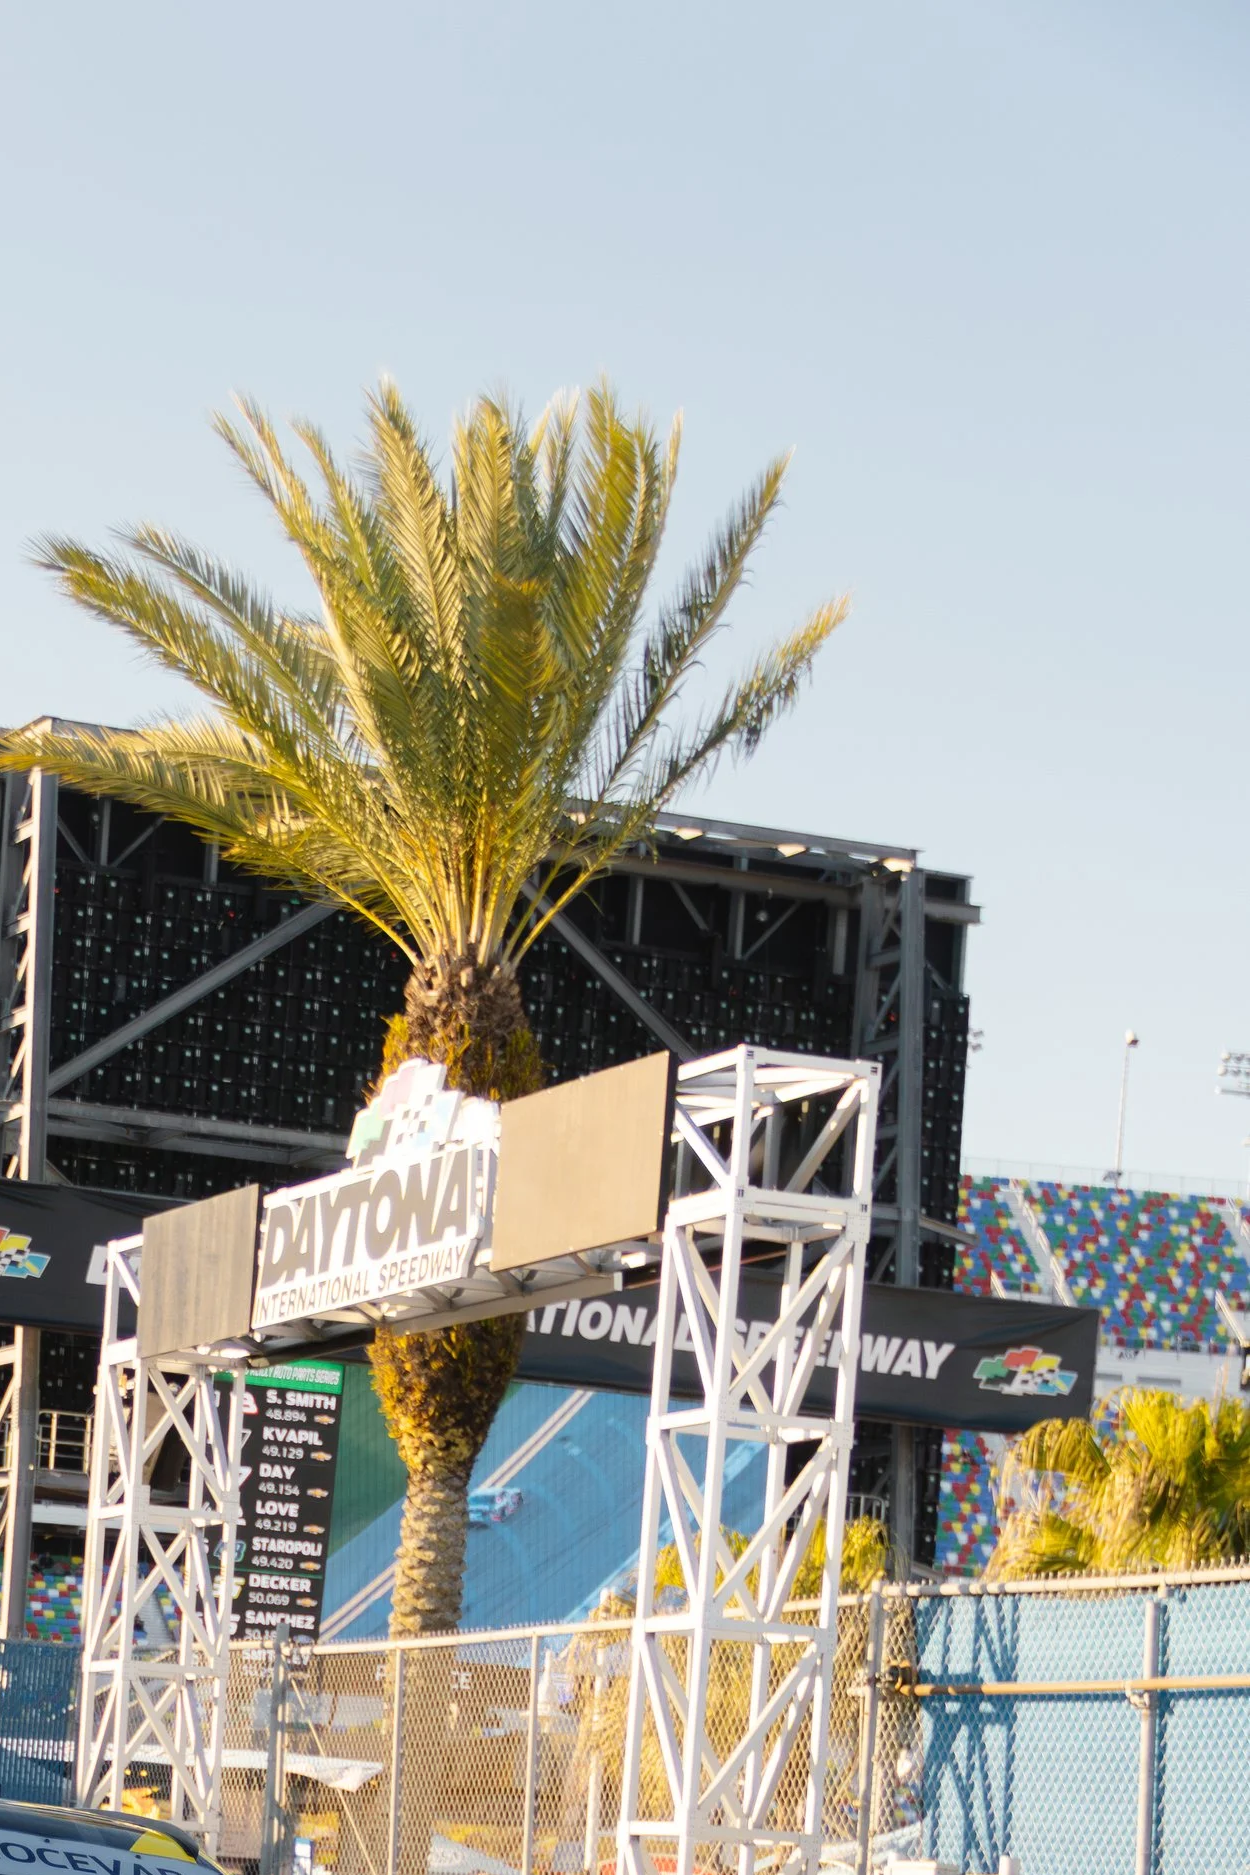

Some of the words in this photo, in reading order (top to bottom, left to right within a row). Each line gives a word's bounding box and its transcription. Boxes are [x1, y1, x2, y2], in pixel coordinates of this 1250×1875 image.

[259, 1147, 470, 1289] DAYTONA
[254, 1271, 370, 1323] INTERNATIONAL
[377, 1242, 466, 1292] SPEEDWAY
[314, 1369, 340, 1385] SERIES
[265, 1389, 282, 1404] S.
[285, 1390, 337, 1411] SMITH
[265, 1408, 307, 1423] 48.894
[262, 1426, 323, 1446] KVAPIL
[262, 1445, 304, 1460] 49.129
[259, 1463, 296, 1480] DAY
[258, 1482, 300, 1497] 49.154
[255, 1500, 300, 1518] LOVE
[255, 1518, 297, 1533] 49.219
[252, 1536, 323, 1557] STAROPOLI
[251, 1555, 293, 1570] 49.420
[249, 1574, 311, 1592] DECKER
[248, 1592, 290, 1606] 50.069
[245, 1610, 315, 1630] SANCHEZ
